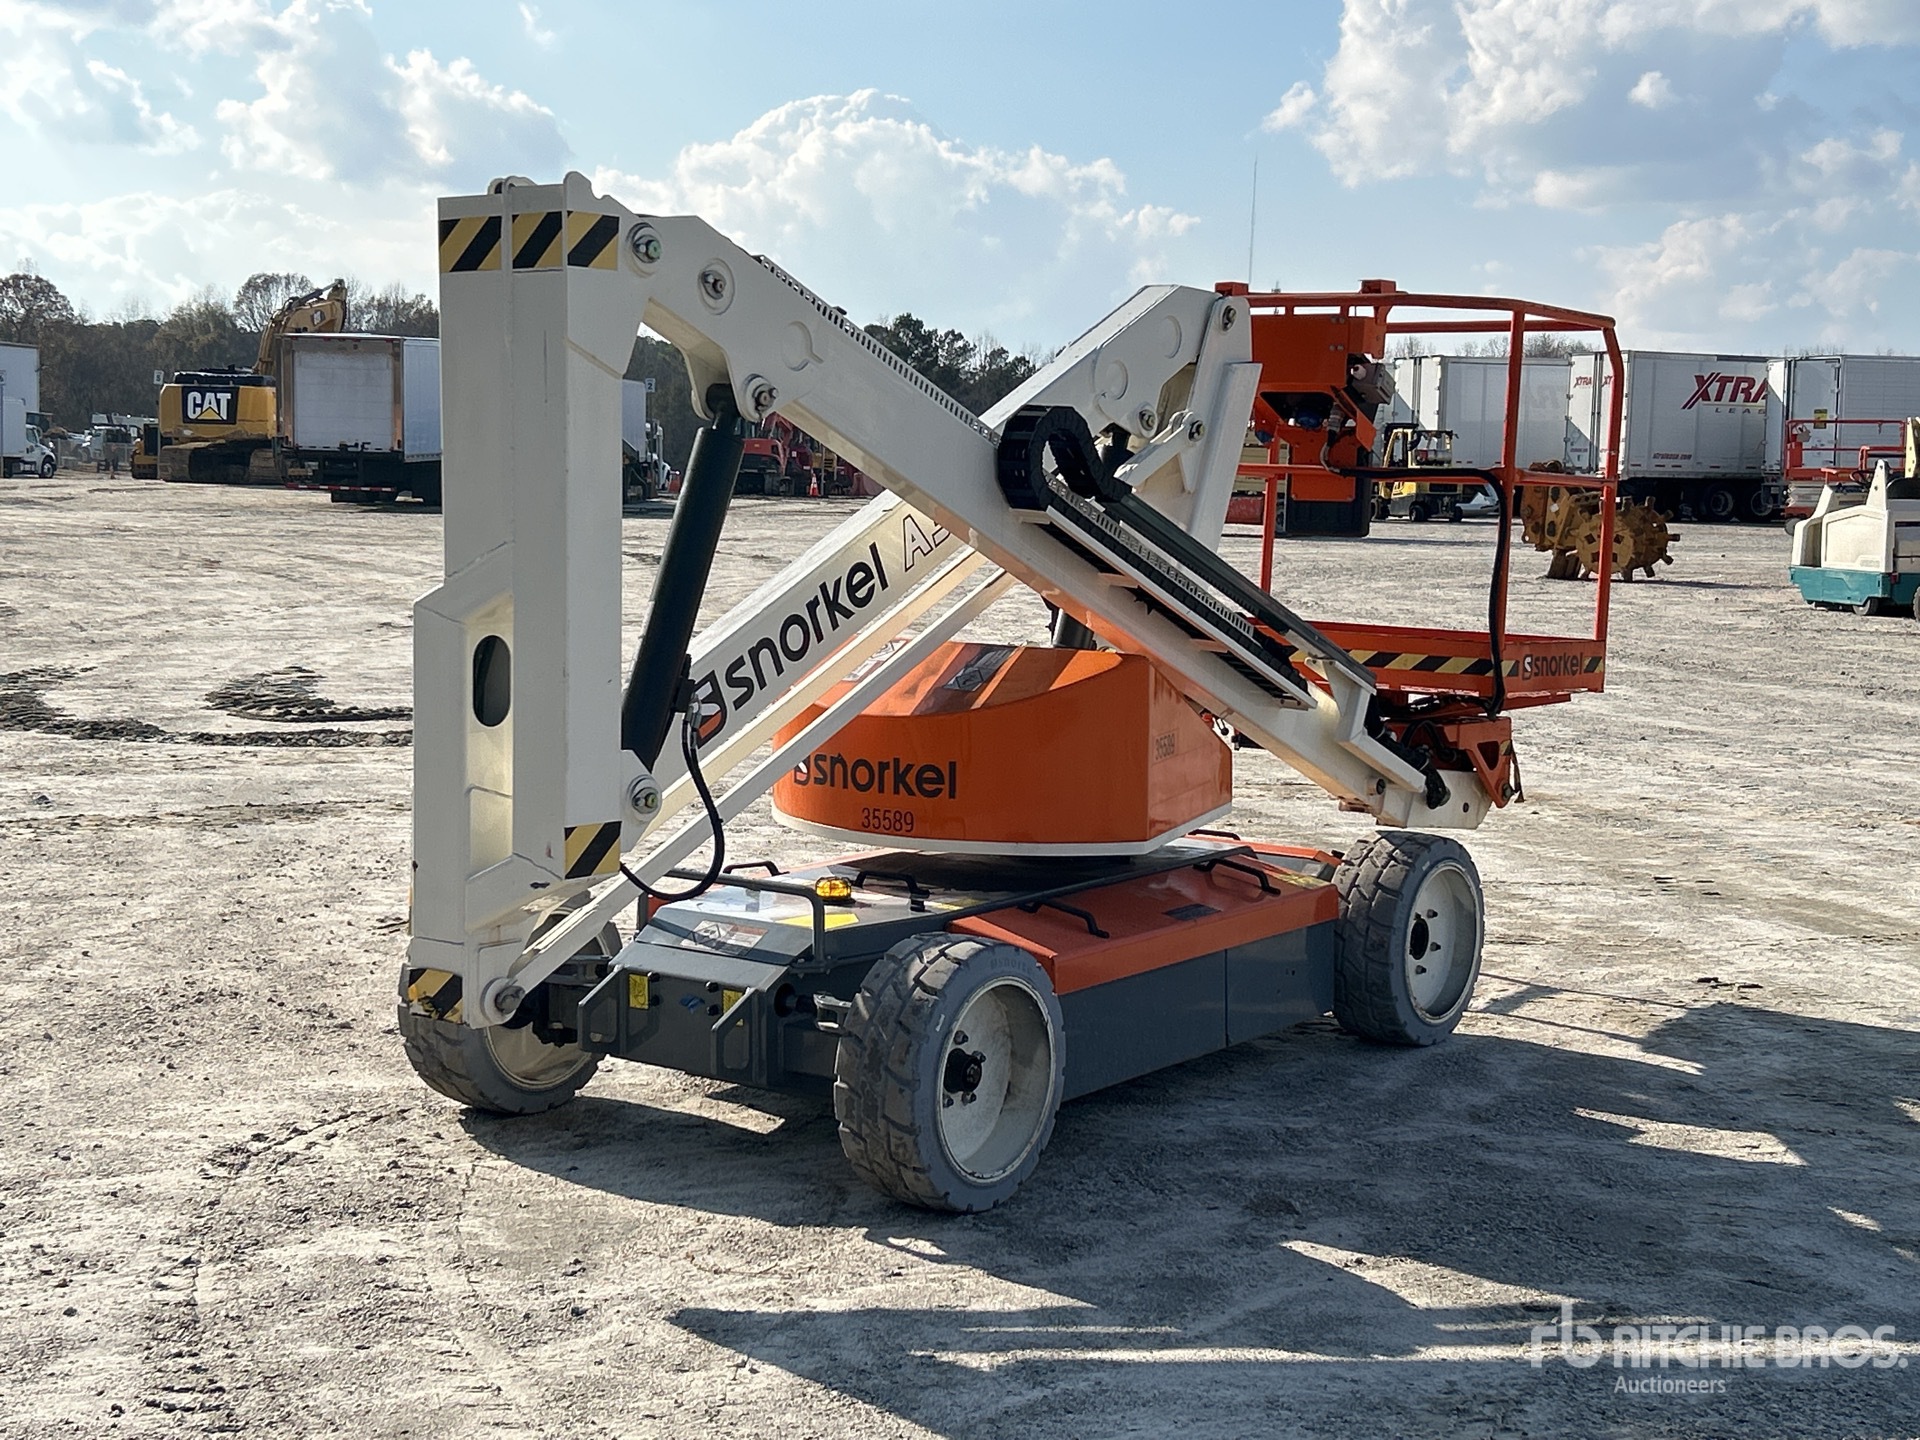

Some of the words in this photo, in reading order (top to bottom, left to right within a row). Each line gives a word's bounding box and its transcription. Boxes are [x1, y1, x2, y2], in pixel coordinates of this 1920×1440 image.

[1573, 376, 1592, 388] XTRA
[187, 391, 232, 421] CAT
[725, 542, 889, 712] snorkel
[1533, 653, 1583, 676] snorkel
[813, 753, 957, 800] snorkel
[861, 807, 914, 832] 35589
